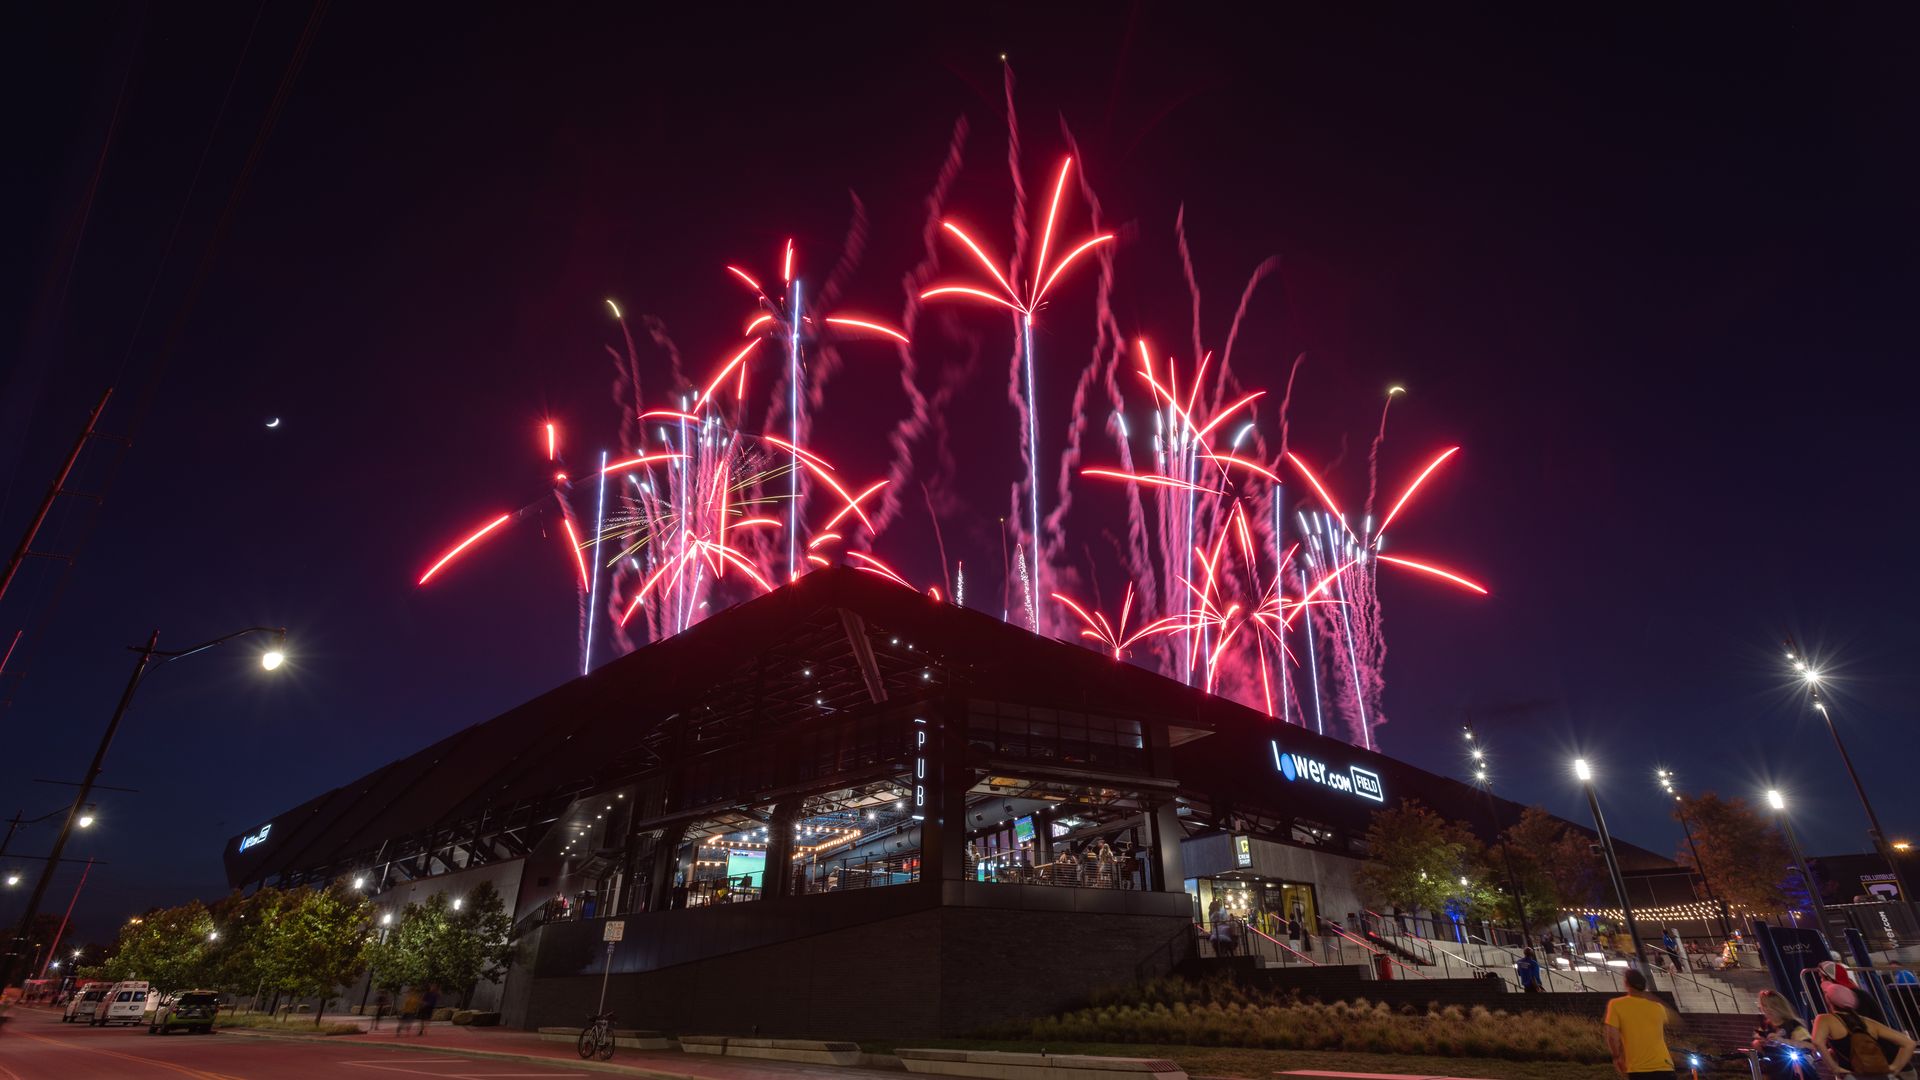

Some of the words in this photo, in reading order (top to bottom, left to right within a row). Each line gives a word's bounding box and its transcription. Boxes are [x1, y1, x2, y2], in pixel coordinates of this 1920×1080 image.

[917, 731, 925, 806] PUB
[1356, 774, 1378, 793] FIELD
[1860, 873, 1896, 881] COLUMBUS
